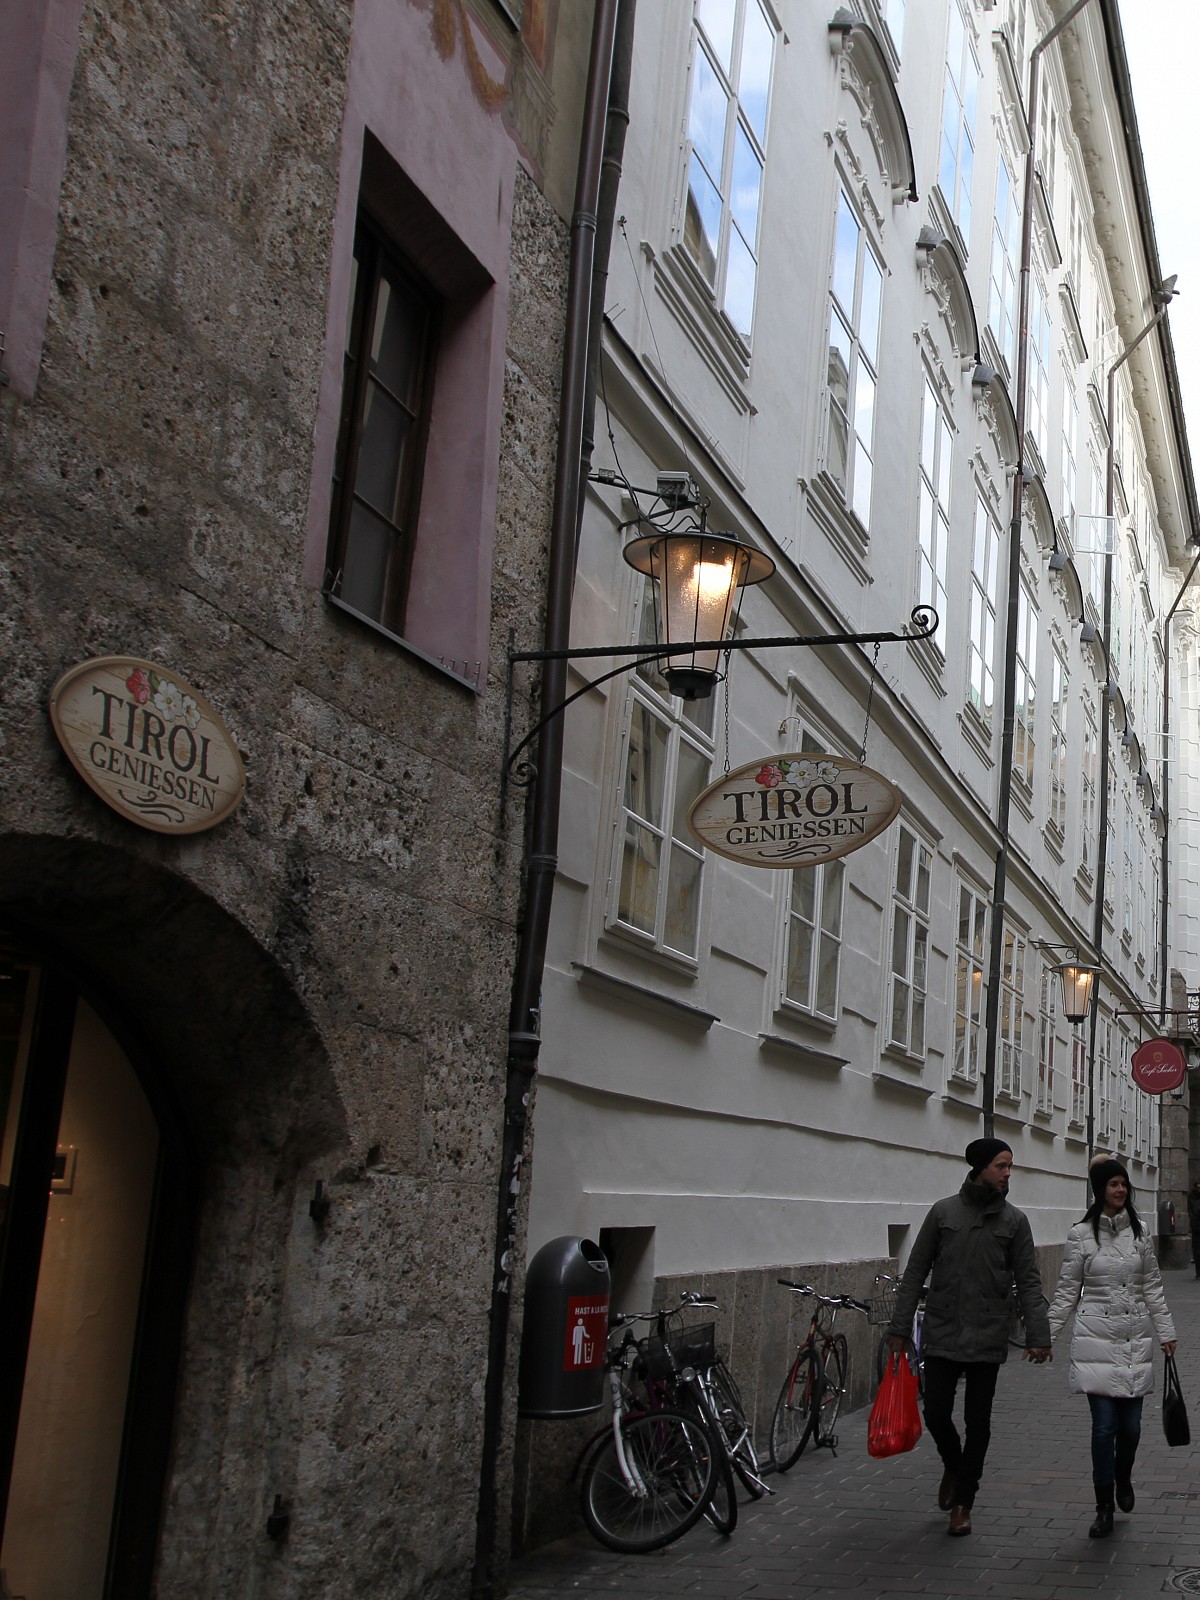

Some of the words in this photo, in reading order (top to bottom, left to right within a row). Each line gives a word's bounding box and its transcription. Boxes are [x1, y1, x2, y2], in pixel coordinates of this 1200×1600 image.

[92, 685, 220, 785] TIROL
[89, 741, 217, 812] GENIESSEN
[723, 782, 868, 824] TIROL
[726, 816, 866, 845] GENIESSEN
[574, 1306, 590, 1315] HAST
